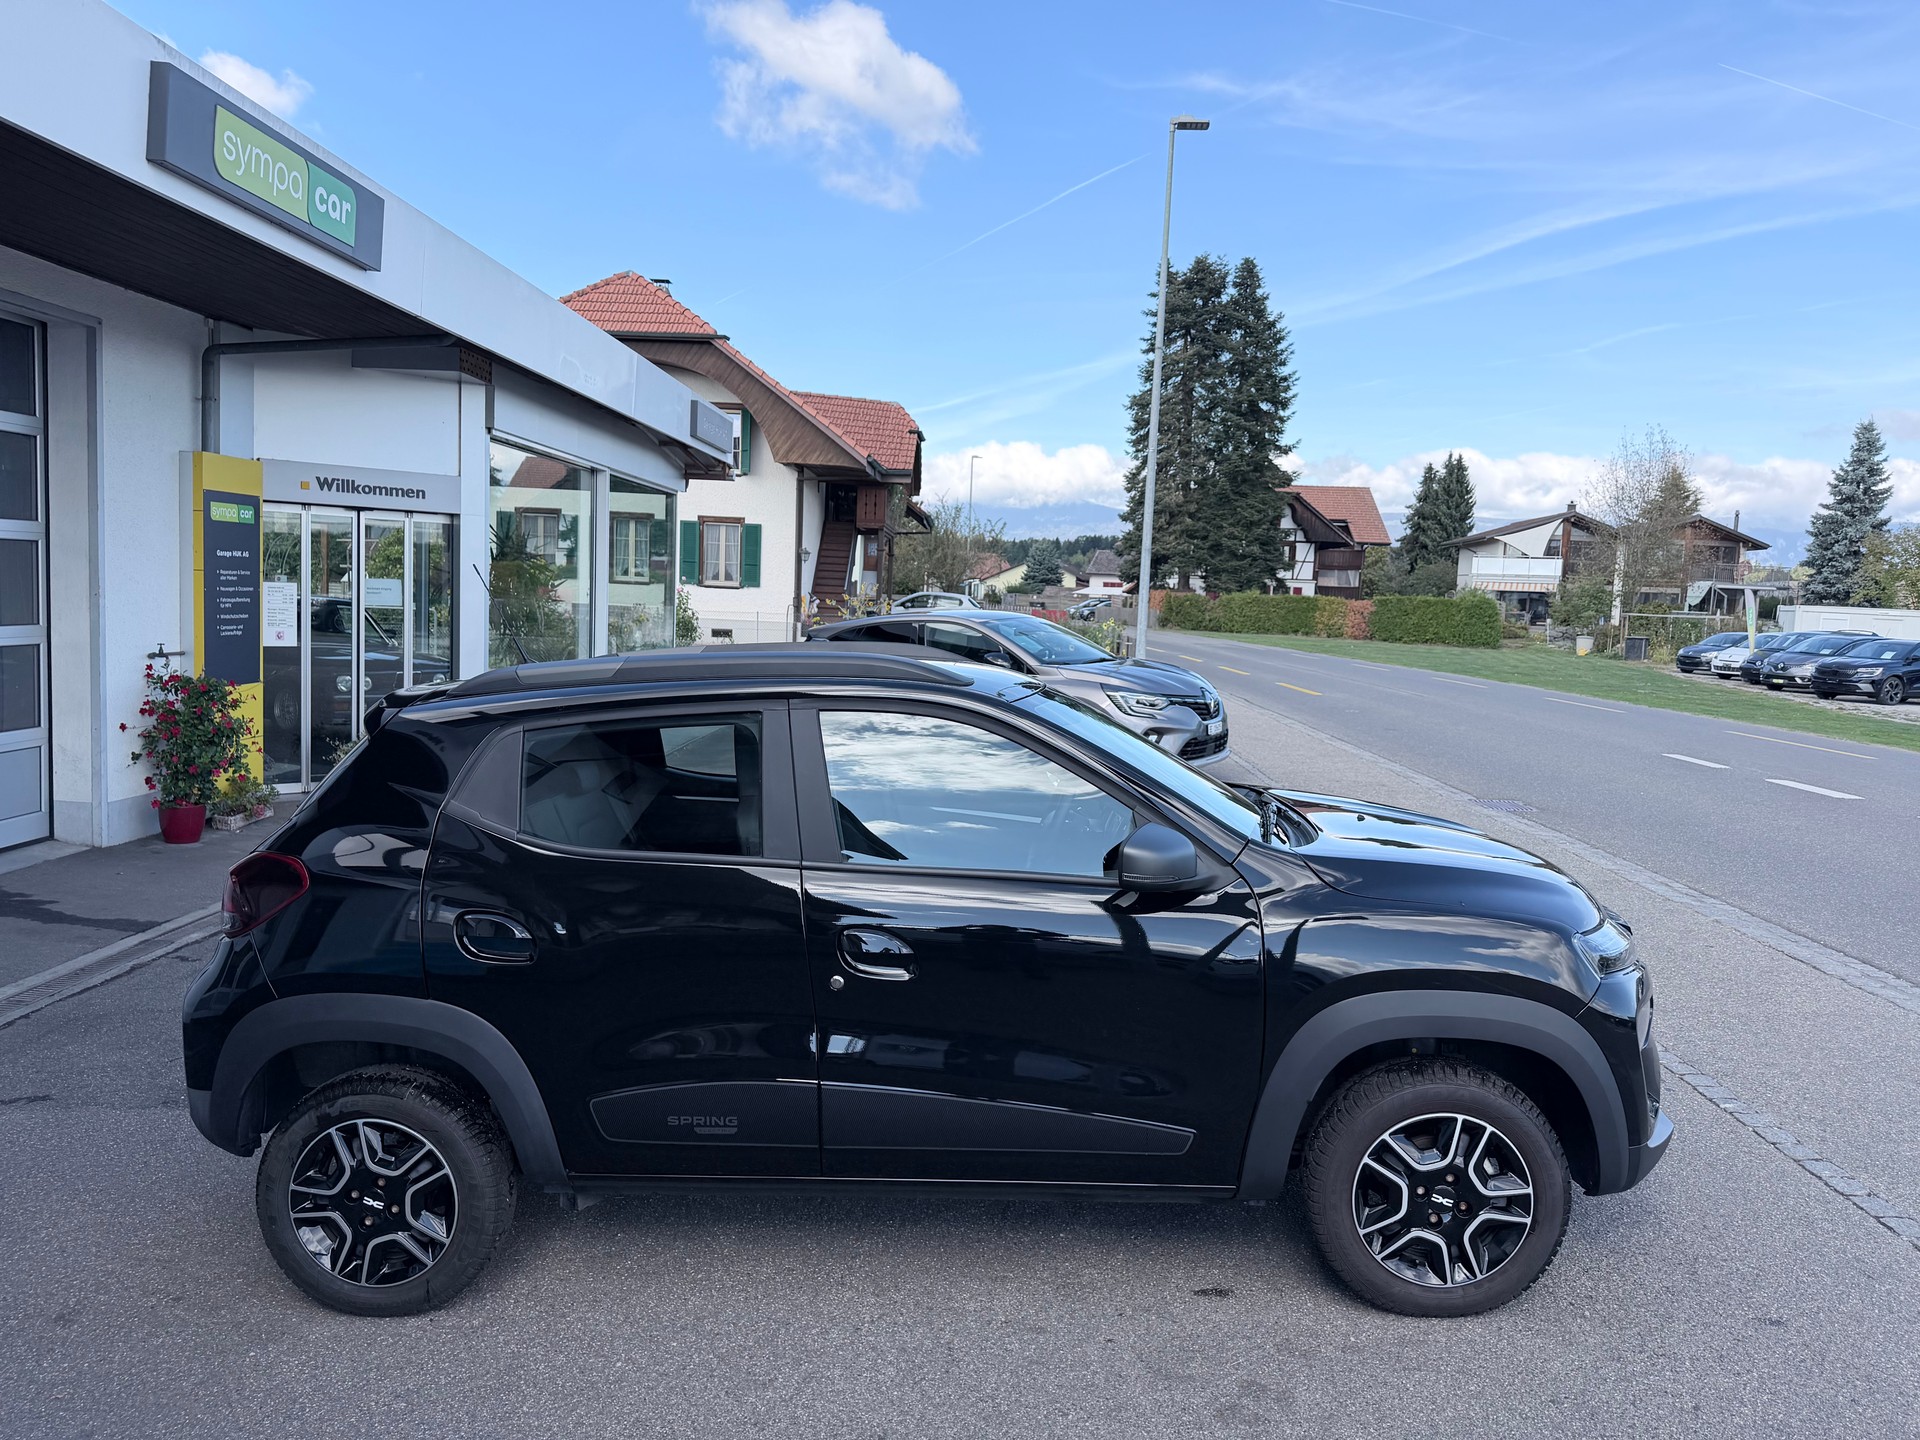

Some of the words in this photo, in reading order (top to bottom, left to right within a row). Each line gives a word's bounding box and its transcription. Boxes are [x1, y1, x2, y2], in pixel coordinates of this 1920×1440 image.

[223, 130, 302, 200] sympa
[314, 186, 351, 225] car
[315, 475, 426, 500] Willkommen
[212, 506, 237, 519] sympa
[240, 509, 253, 519] car
[216, 549, 232, 558] Garage
[242, 550, 250, 558] AG
[667, 1115, 738, 1126] SPRING
